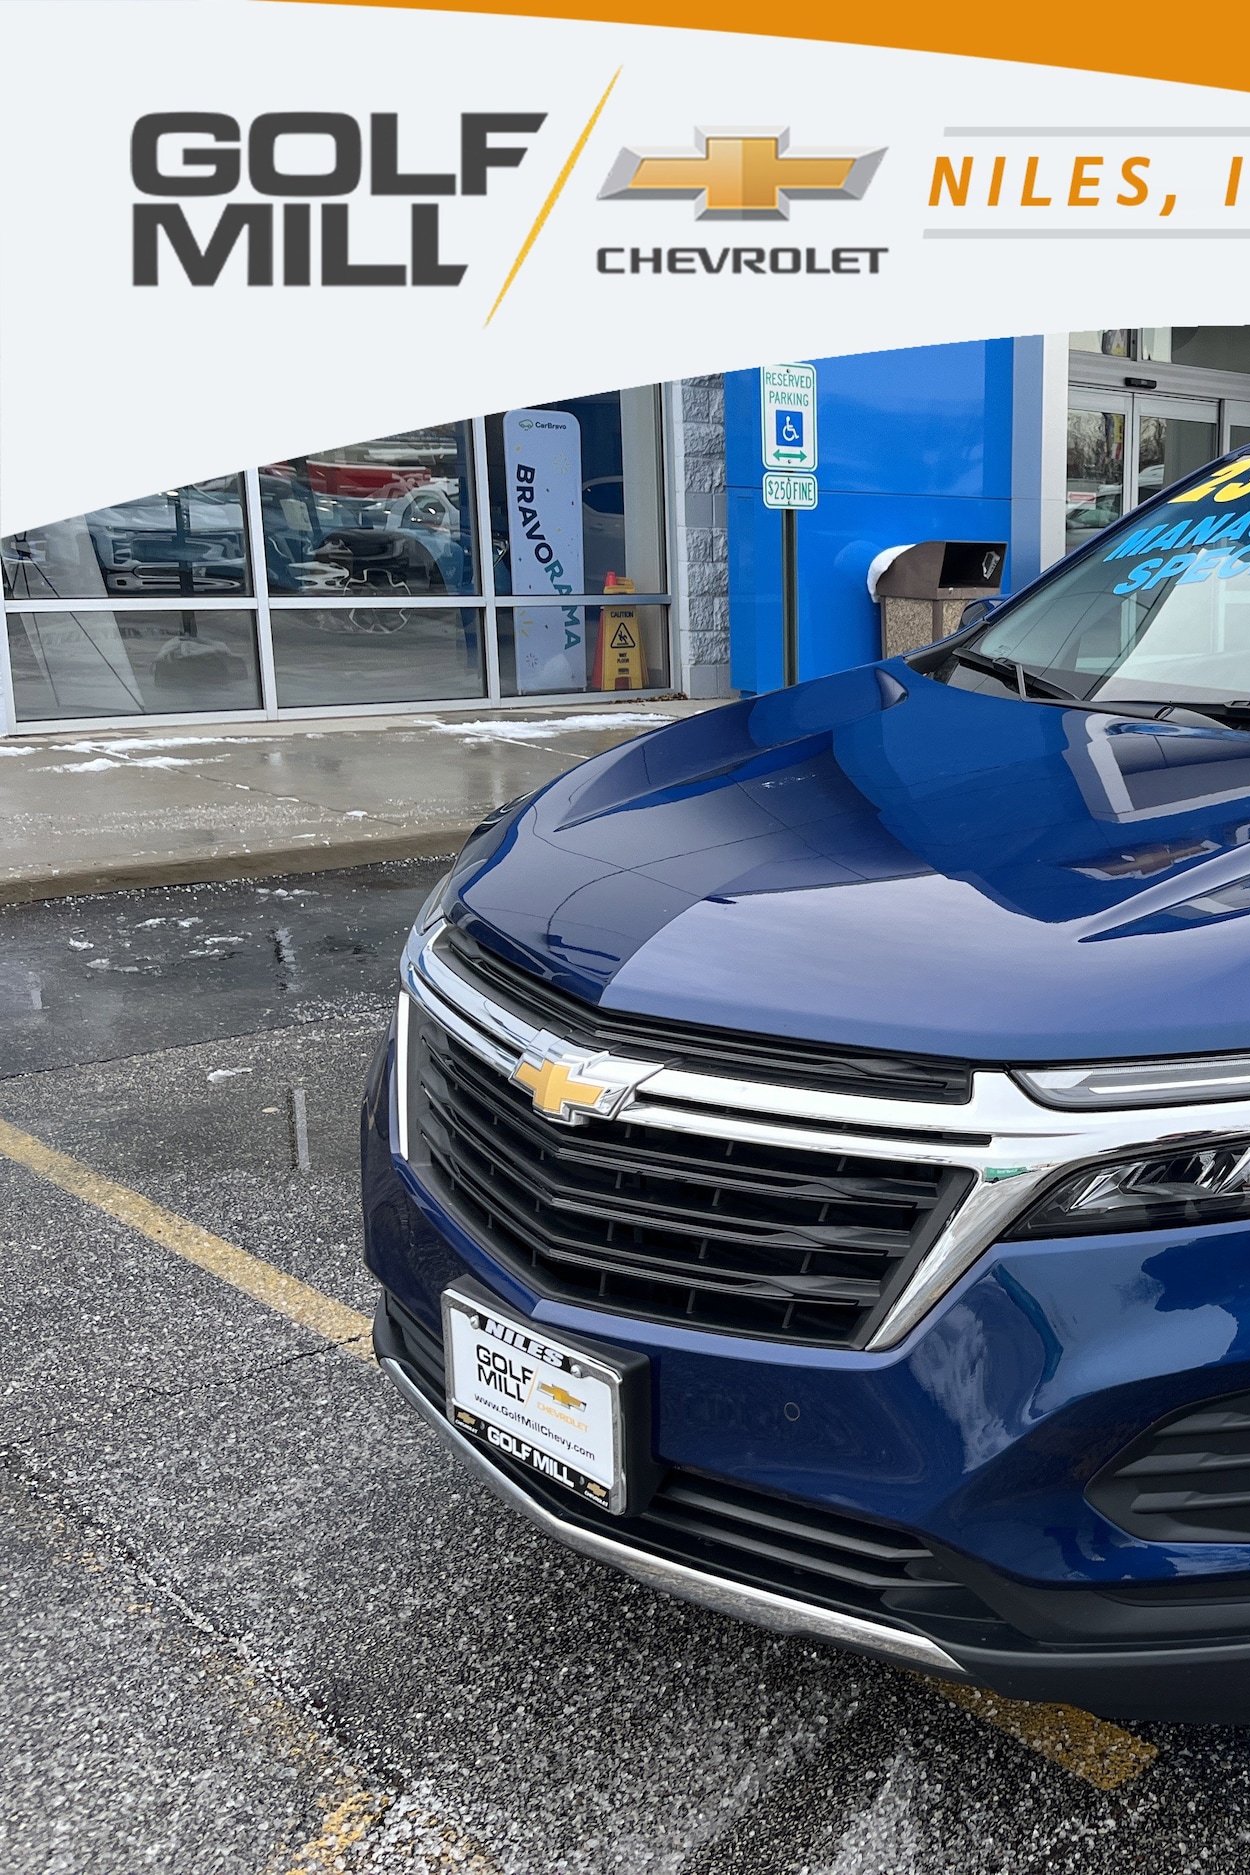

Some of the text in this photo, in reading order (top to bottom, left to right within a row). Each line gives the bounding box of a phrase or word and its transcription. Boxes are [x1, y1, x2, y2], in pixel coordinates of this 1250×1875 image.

[765, 372, 812, 389] RESERVED
[769, 391, 809, 407] PARKING
[535, 421, 567, 430] CarBravo
[768, 480, 813, 501] $250 FINE
[516, 463, 581, 650] BRAVORAMA
[484, 1318, 563, 1368] NILES
[476, 1344, 534, 1385] GOLF
[477, 1363, 525, 1404] MILL
[474, 1393, 595, 1461] www.GolfMillChevy.com
[536, 1402, 590, 1433] CHEVROLET
[487, 1425, 575, 1488] GOLF MILL
